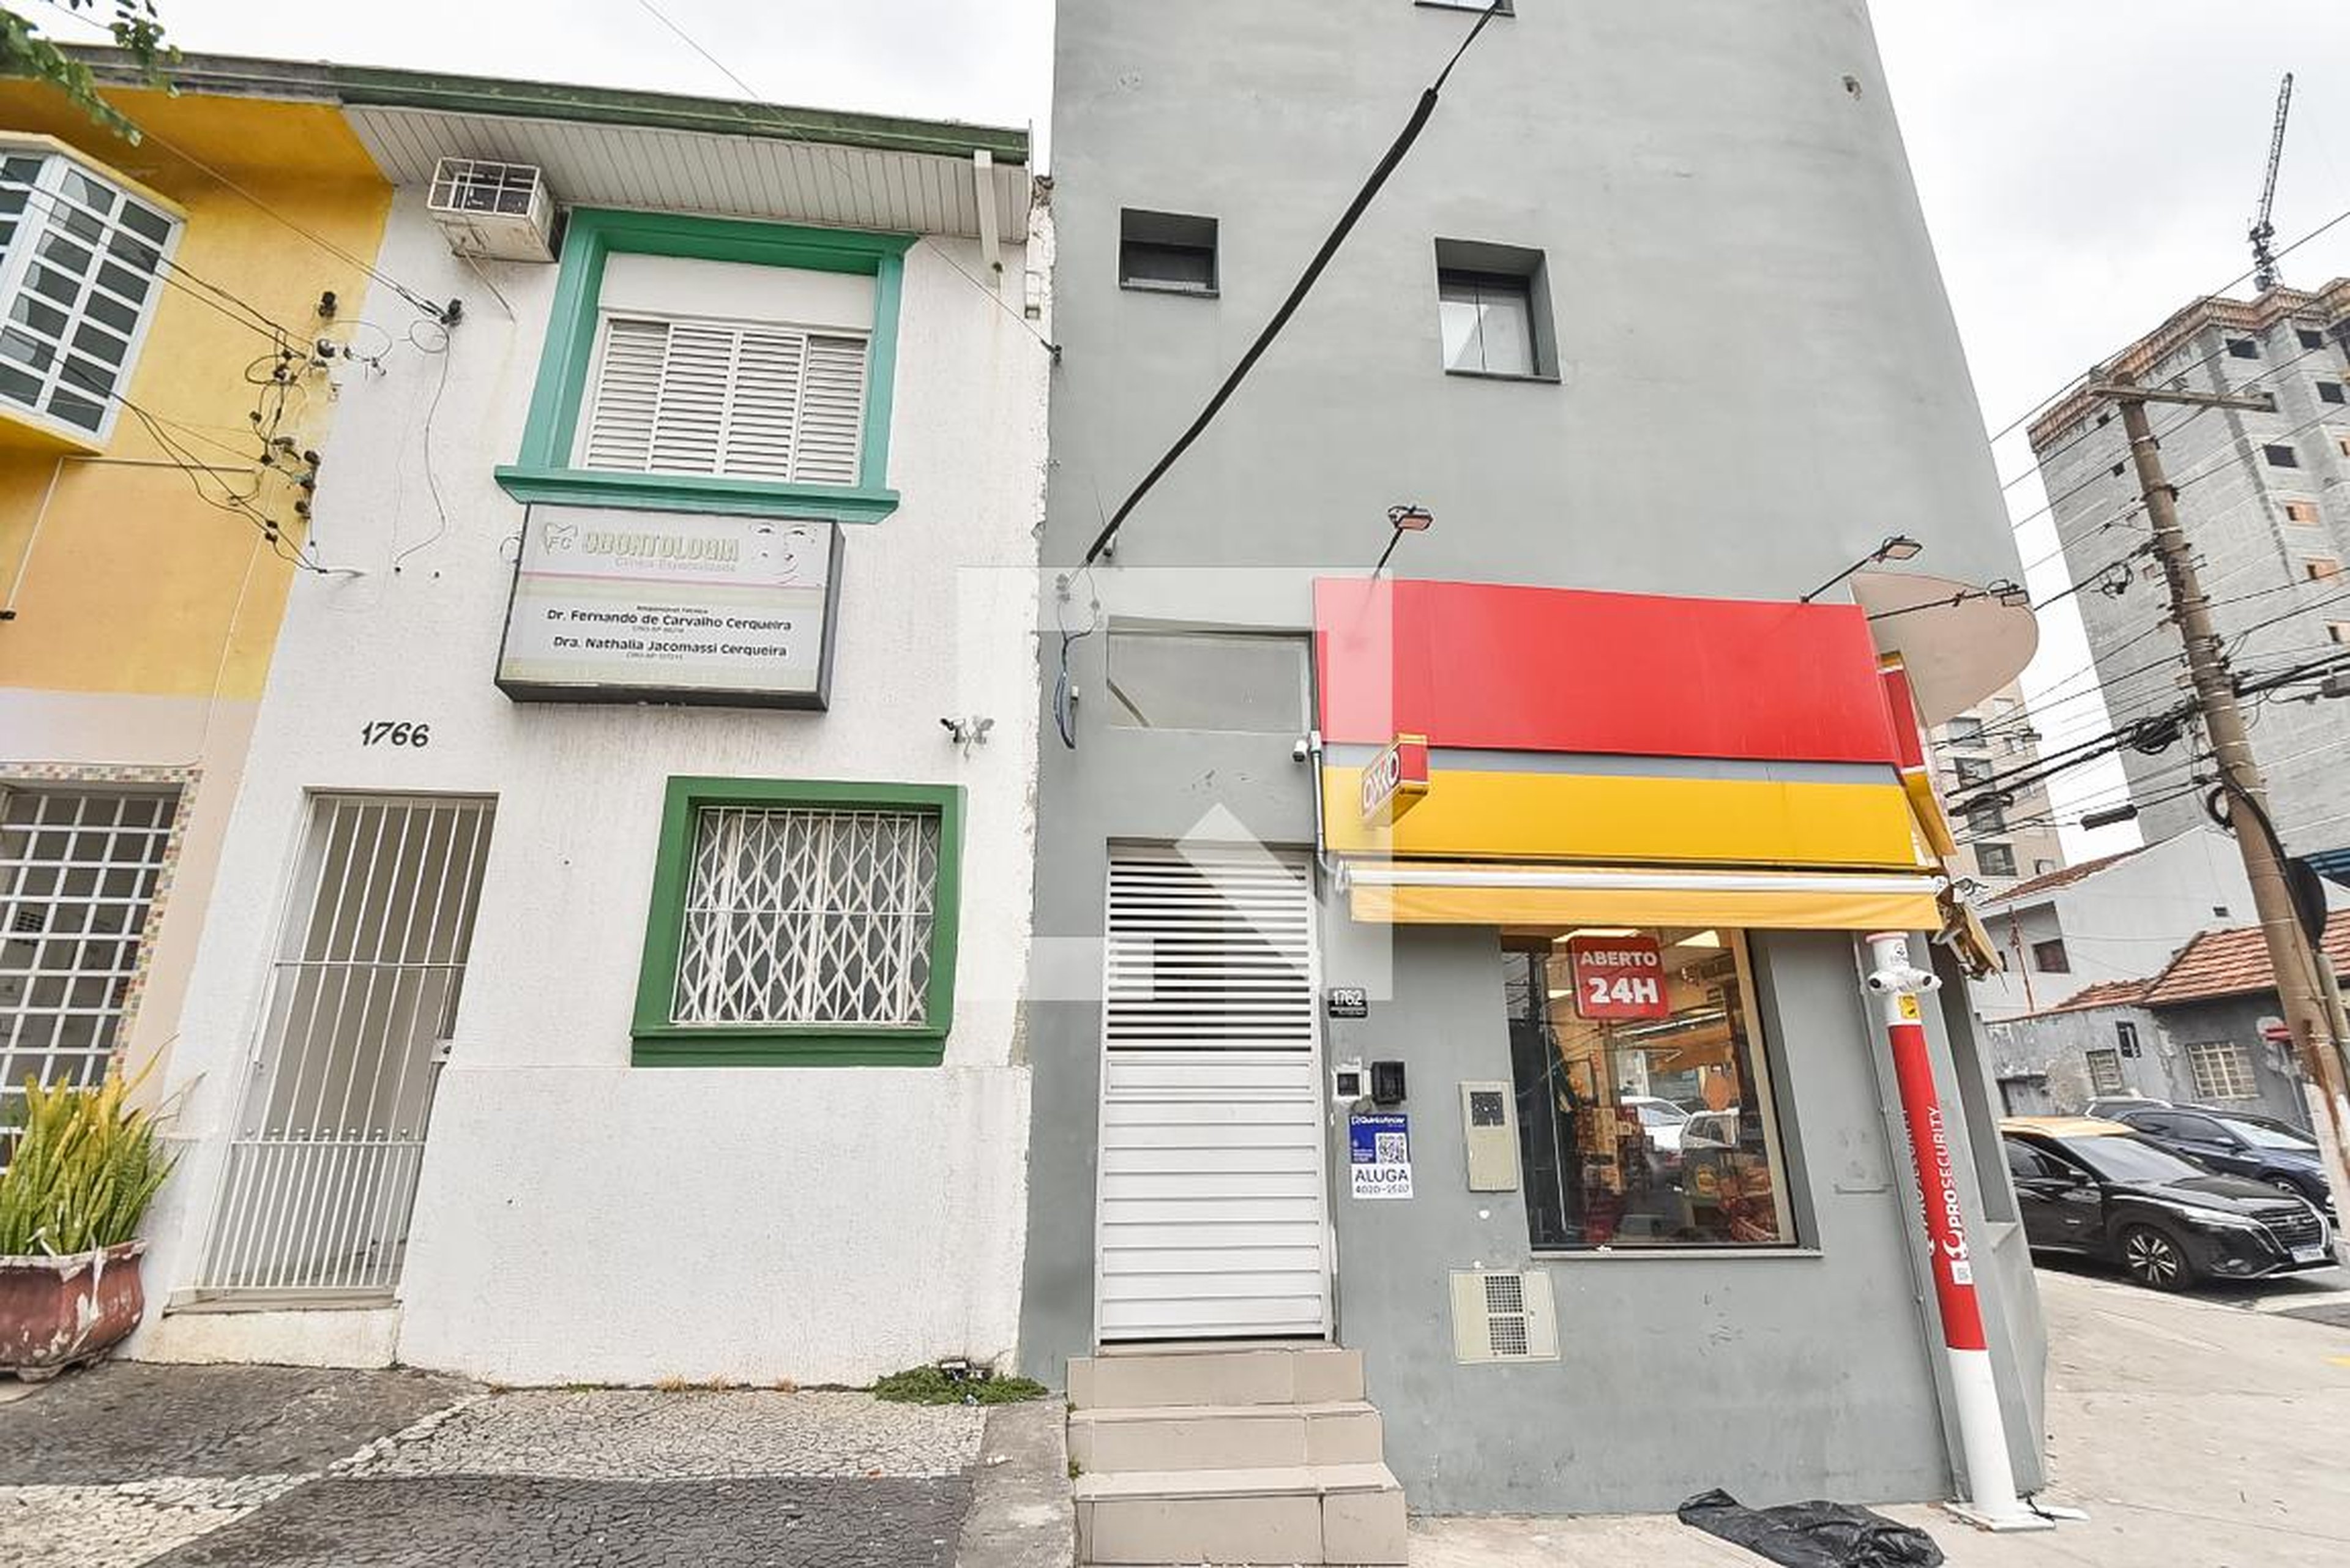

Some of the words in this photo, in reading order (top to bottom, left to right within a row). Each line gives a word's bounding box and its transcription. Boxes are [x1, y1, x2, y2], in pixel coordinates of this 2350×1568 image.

[547, 609, 566, 621] Dr.
[571, 610, 638, 624] Fernando
[641, 614, 659, 624] de
[663, 615, 723, 628] Carvalho
[726, 618, 791, 630] Cerqueira
[554, 637, 580, 648] Dra.
[586, 638, 644, 650] Nathalia
[647, 641, 717, 655] Jacomassi
[720, 644, 786, 657] Cerqueira
[362, 721, 429, 747] 1766
[1363, 750, 1400, 808] OXXO
[1581, 951, 1657, 966] ABERTO
[1334, 990, 1362, 1005] 1762
[1588, 978, 1658, 1004] 24H
[1355, 1169, 1408, 1182] ALUGA
